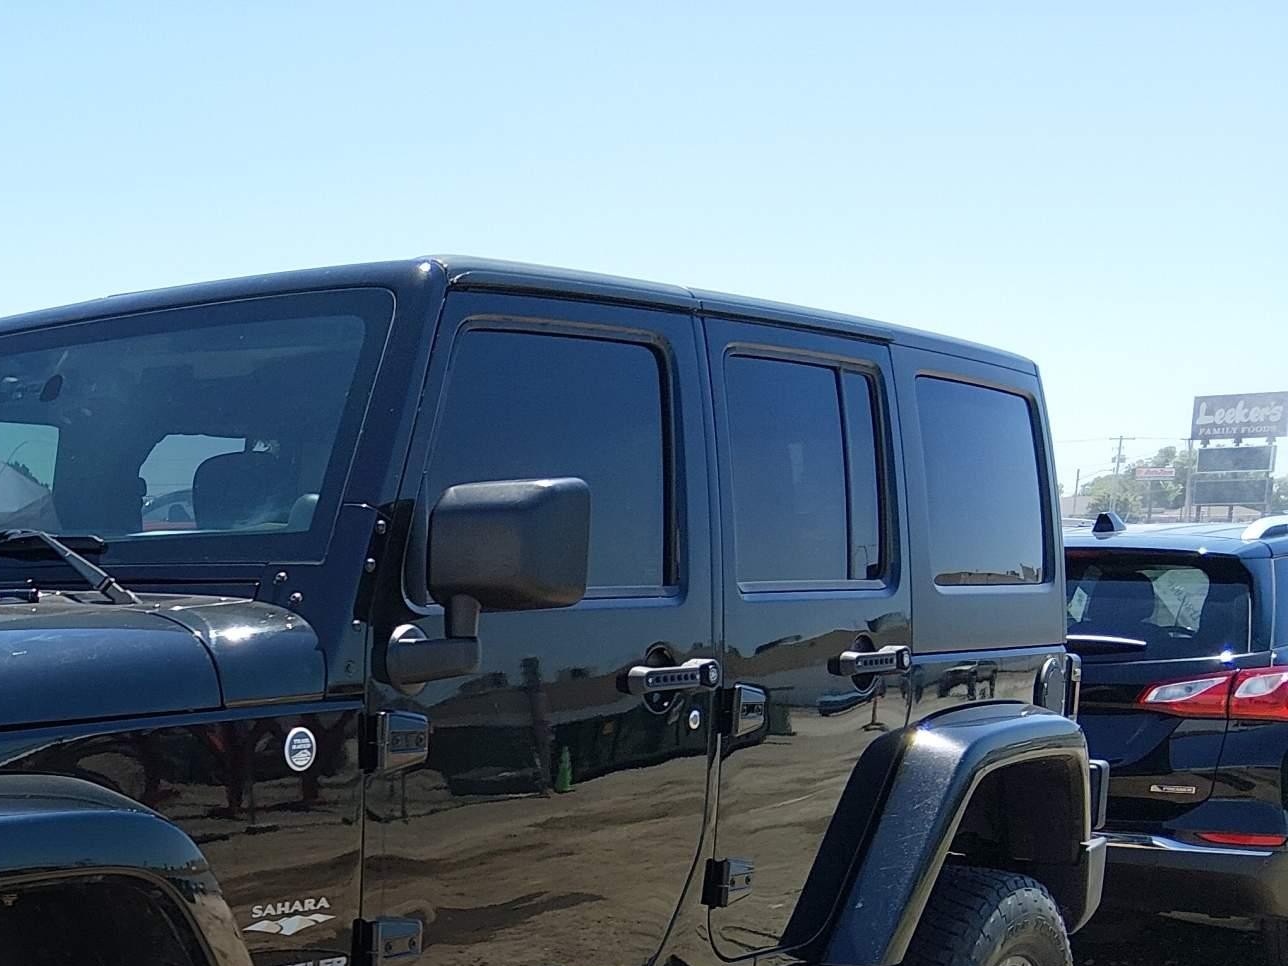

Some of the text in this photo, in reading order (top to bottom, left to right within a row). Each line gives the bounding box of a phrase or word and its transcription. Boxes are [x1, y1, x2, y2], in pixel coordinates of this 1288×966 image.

[1196, 400, 1284, 425] Leeker's
[1199, 427, 1238, 436] FAMILY
[252, 897, 330, 918] SAHARA
